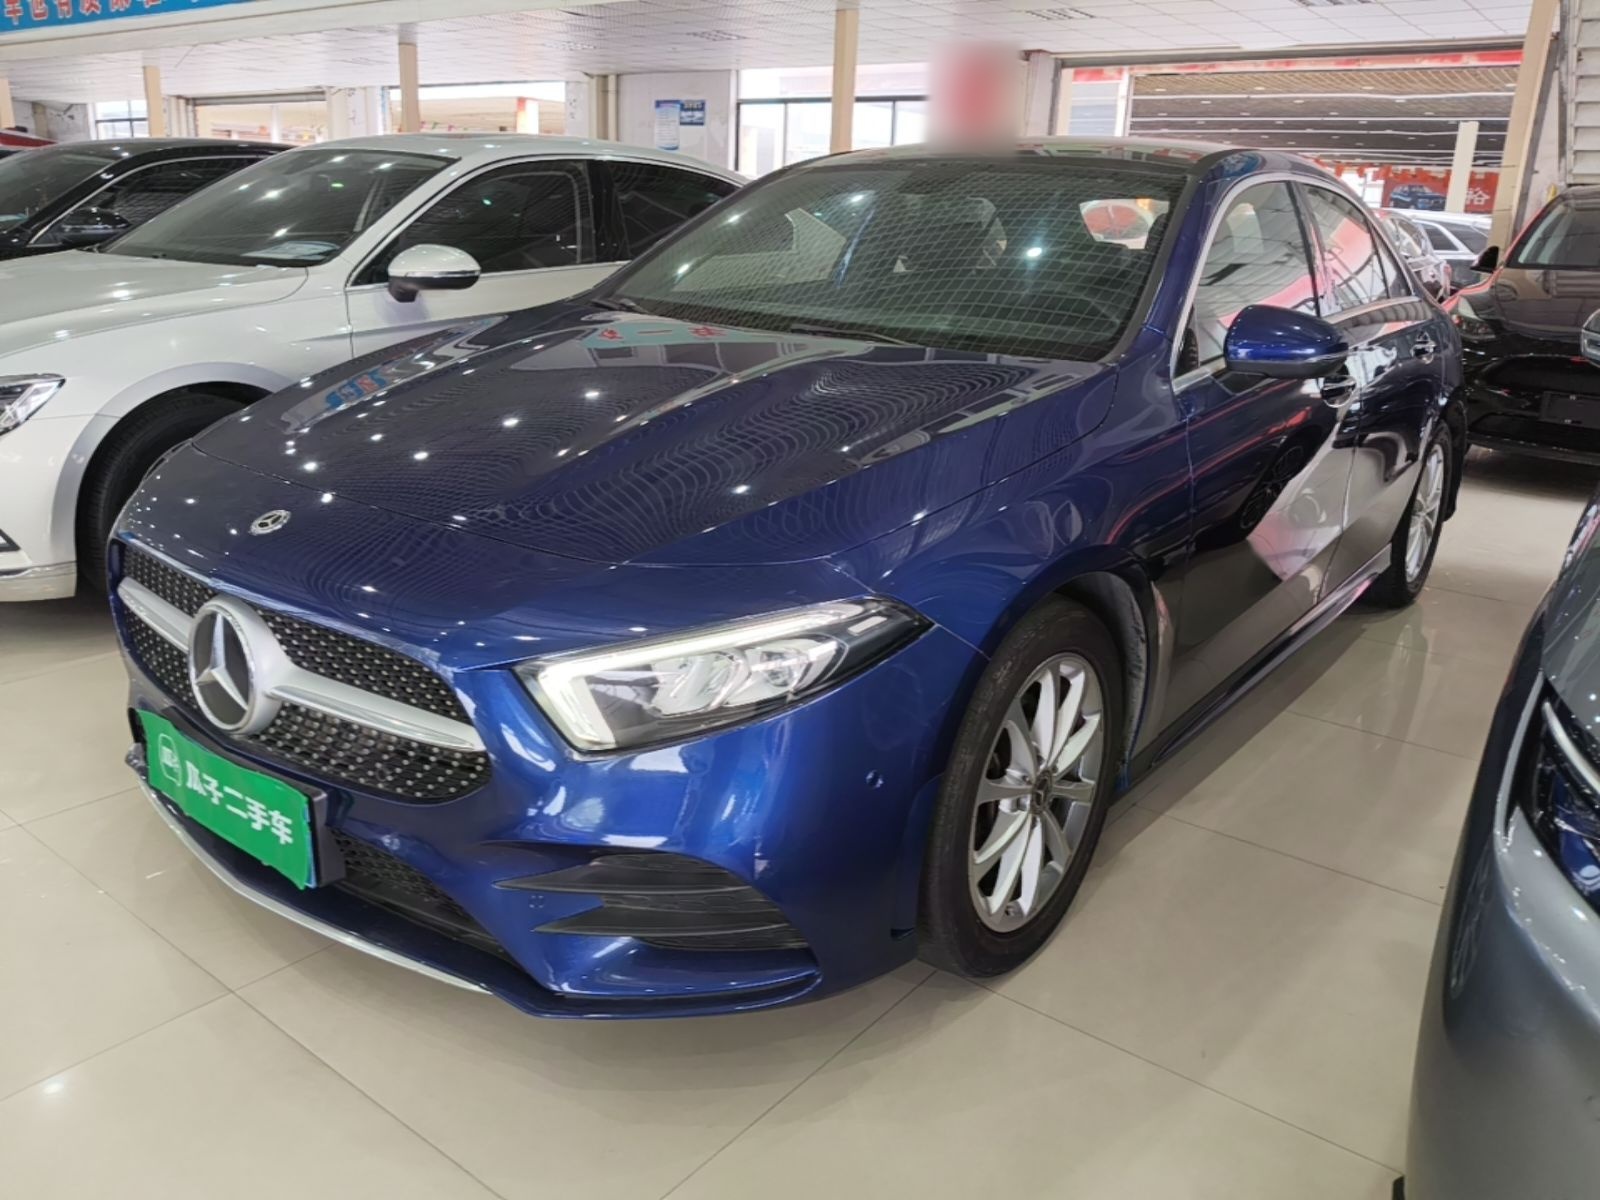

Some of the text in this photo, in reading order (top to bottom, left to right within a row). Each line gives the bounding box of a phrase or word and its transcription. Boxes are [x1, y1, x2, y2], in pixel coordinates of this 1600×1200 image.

[185, 760, 293, 845] 瓜子二手车
